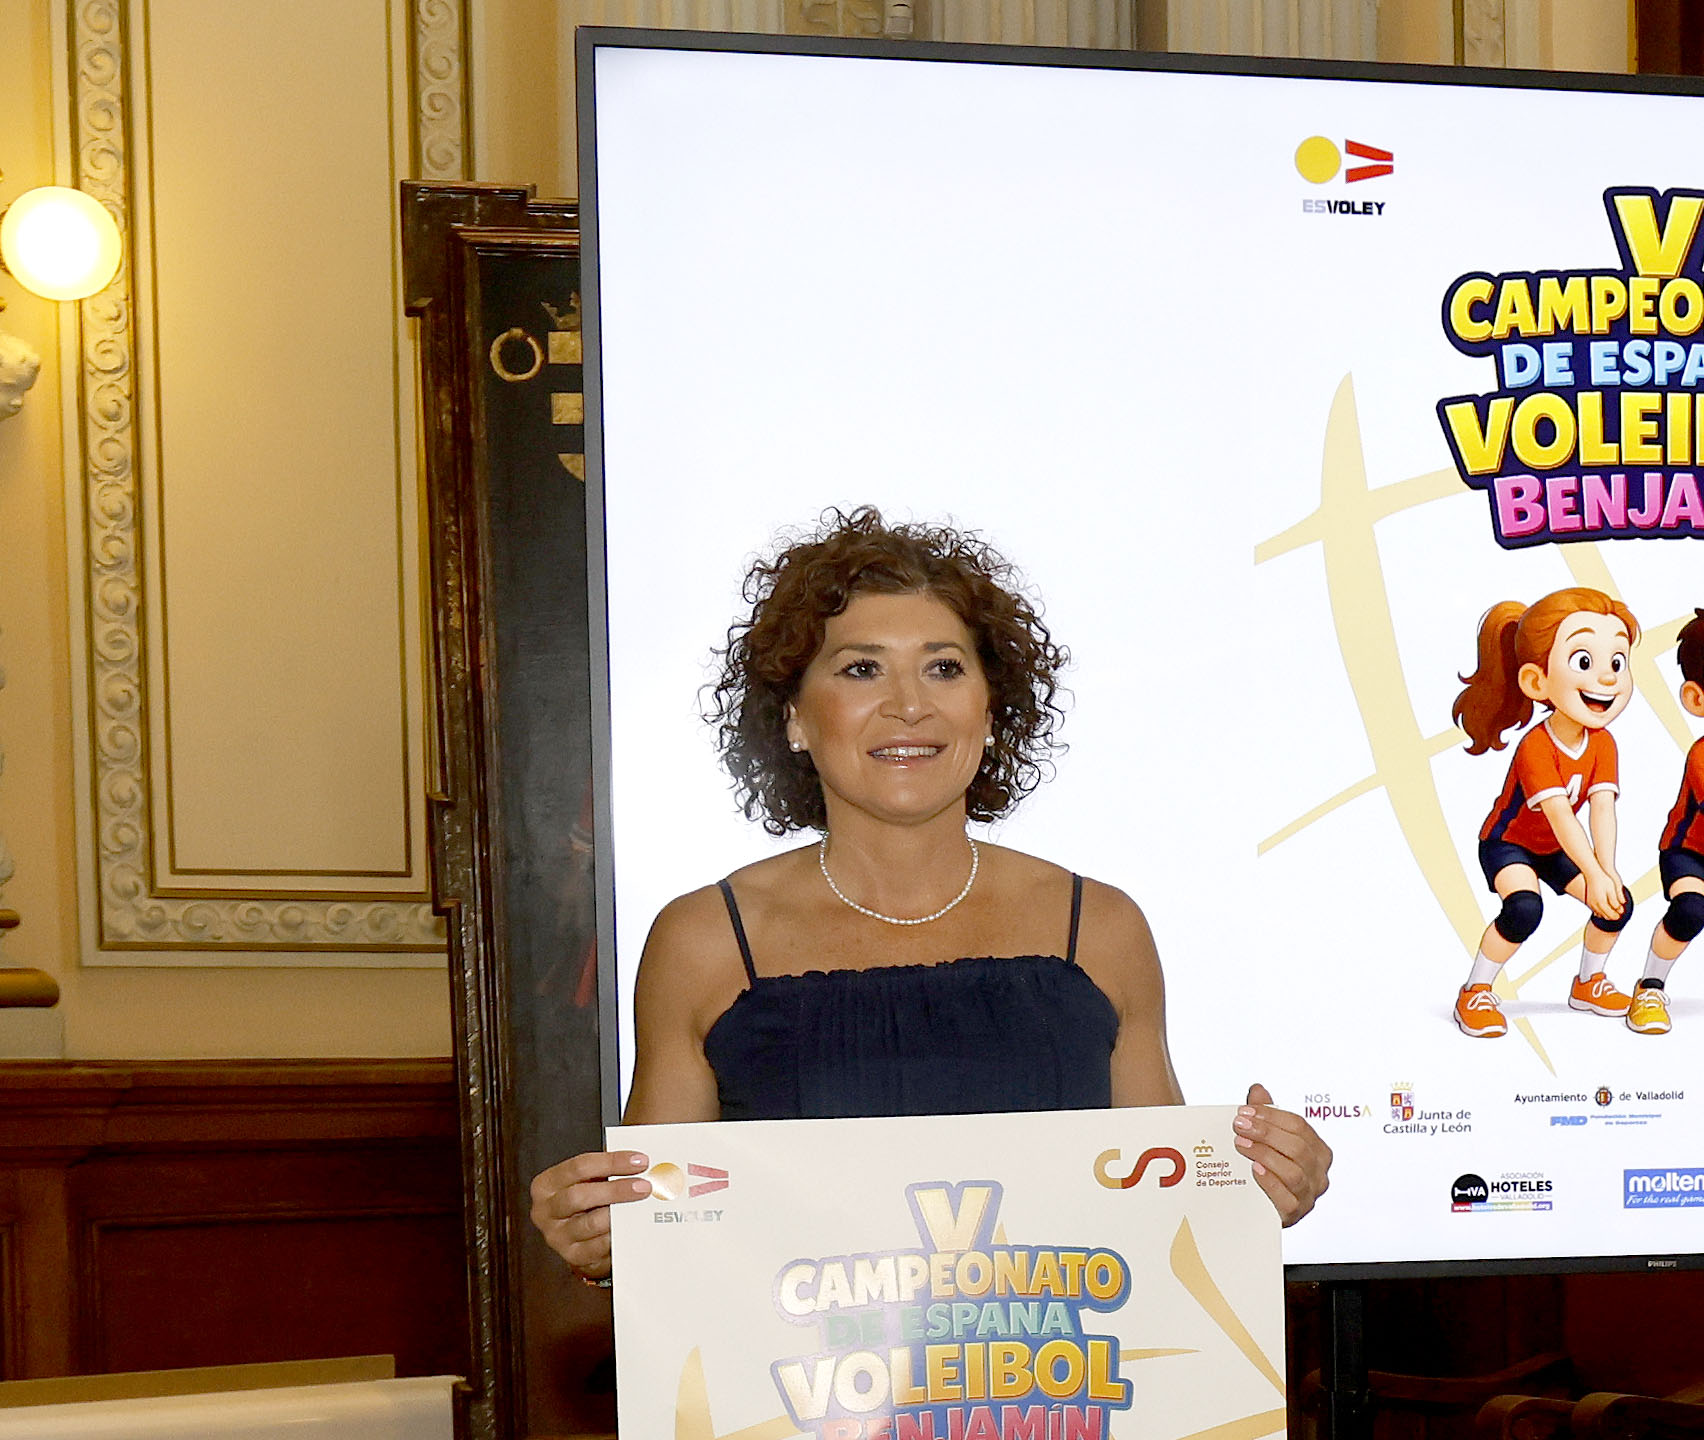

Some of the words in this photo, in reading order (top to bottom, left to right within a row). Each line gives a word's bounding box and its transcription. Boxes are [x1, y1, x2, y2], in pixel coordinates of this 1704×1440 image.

[1302, 199, 1386, 216] ESVOLEY
[1502, 341, 1574, 388] DE
[1304, 1094, 1331, 1103] NOS
[1514, 1092, 1587, 1104] Ayuntamiento
[1619, 1091, 1631, 1101] de
[1636, 1090, 1684, 1101] Valladolid
[1305, 1105, 1372, 1121] IMPULSA
[1417, 1110, 1452, 1120] Junta
[1456, 1109, 1471, 1120] de
[1383, 1123, 1427, 1134] Castilla
[1430, 1125, 1437, 1136] y
[1442, 1122, 1472, 1133] León
[1196, 1160, 1229, 1171] Consejo
[1196, 1169, 1232, 1179] Superior
[1196, 1179, 1207, 1187] de
[1209, 1178, 1247, 1188] Deportes
[1491, 1180, 1552, 1193] HOTELES
[914, 1187, 993, 1251] V
[779, 1251, 1123, 1315] CAMPEONATO
[825, 1310, 887, 1348] DE
[777, 1340, 1125, 1421] VOLEIBOL
